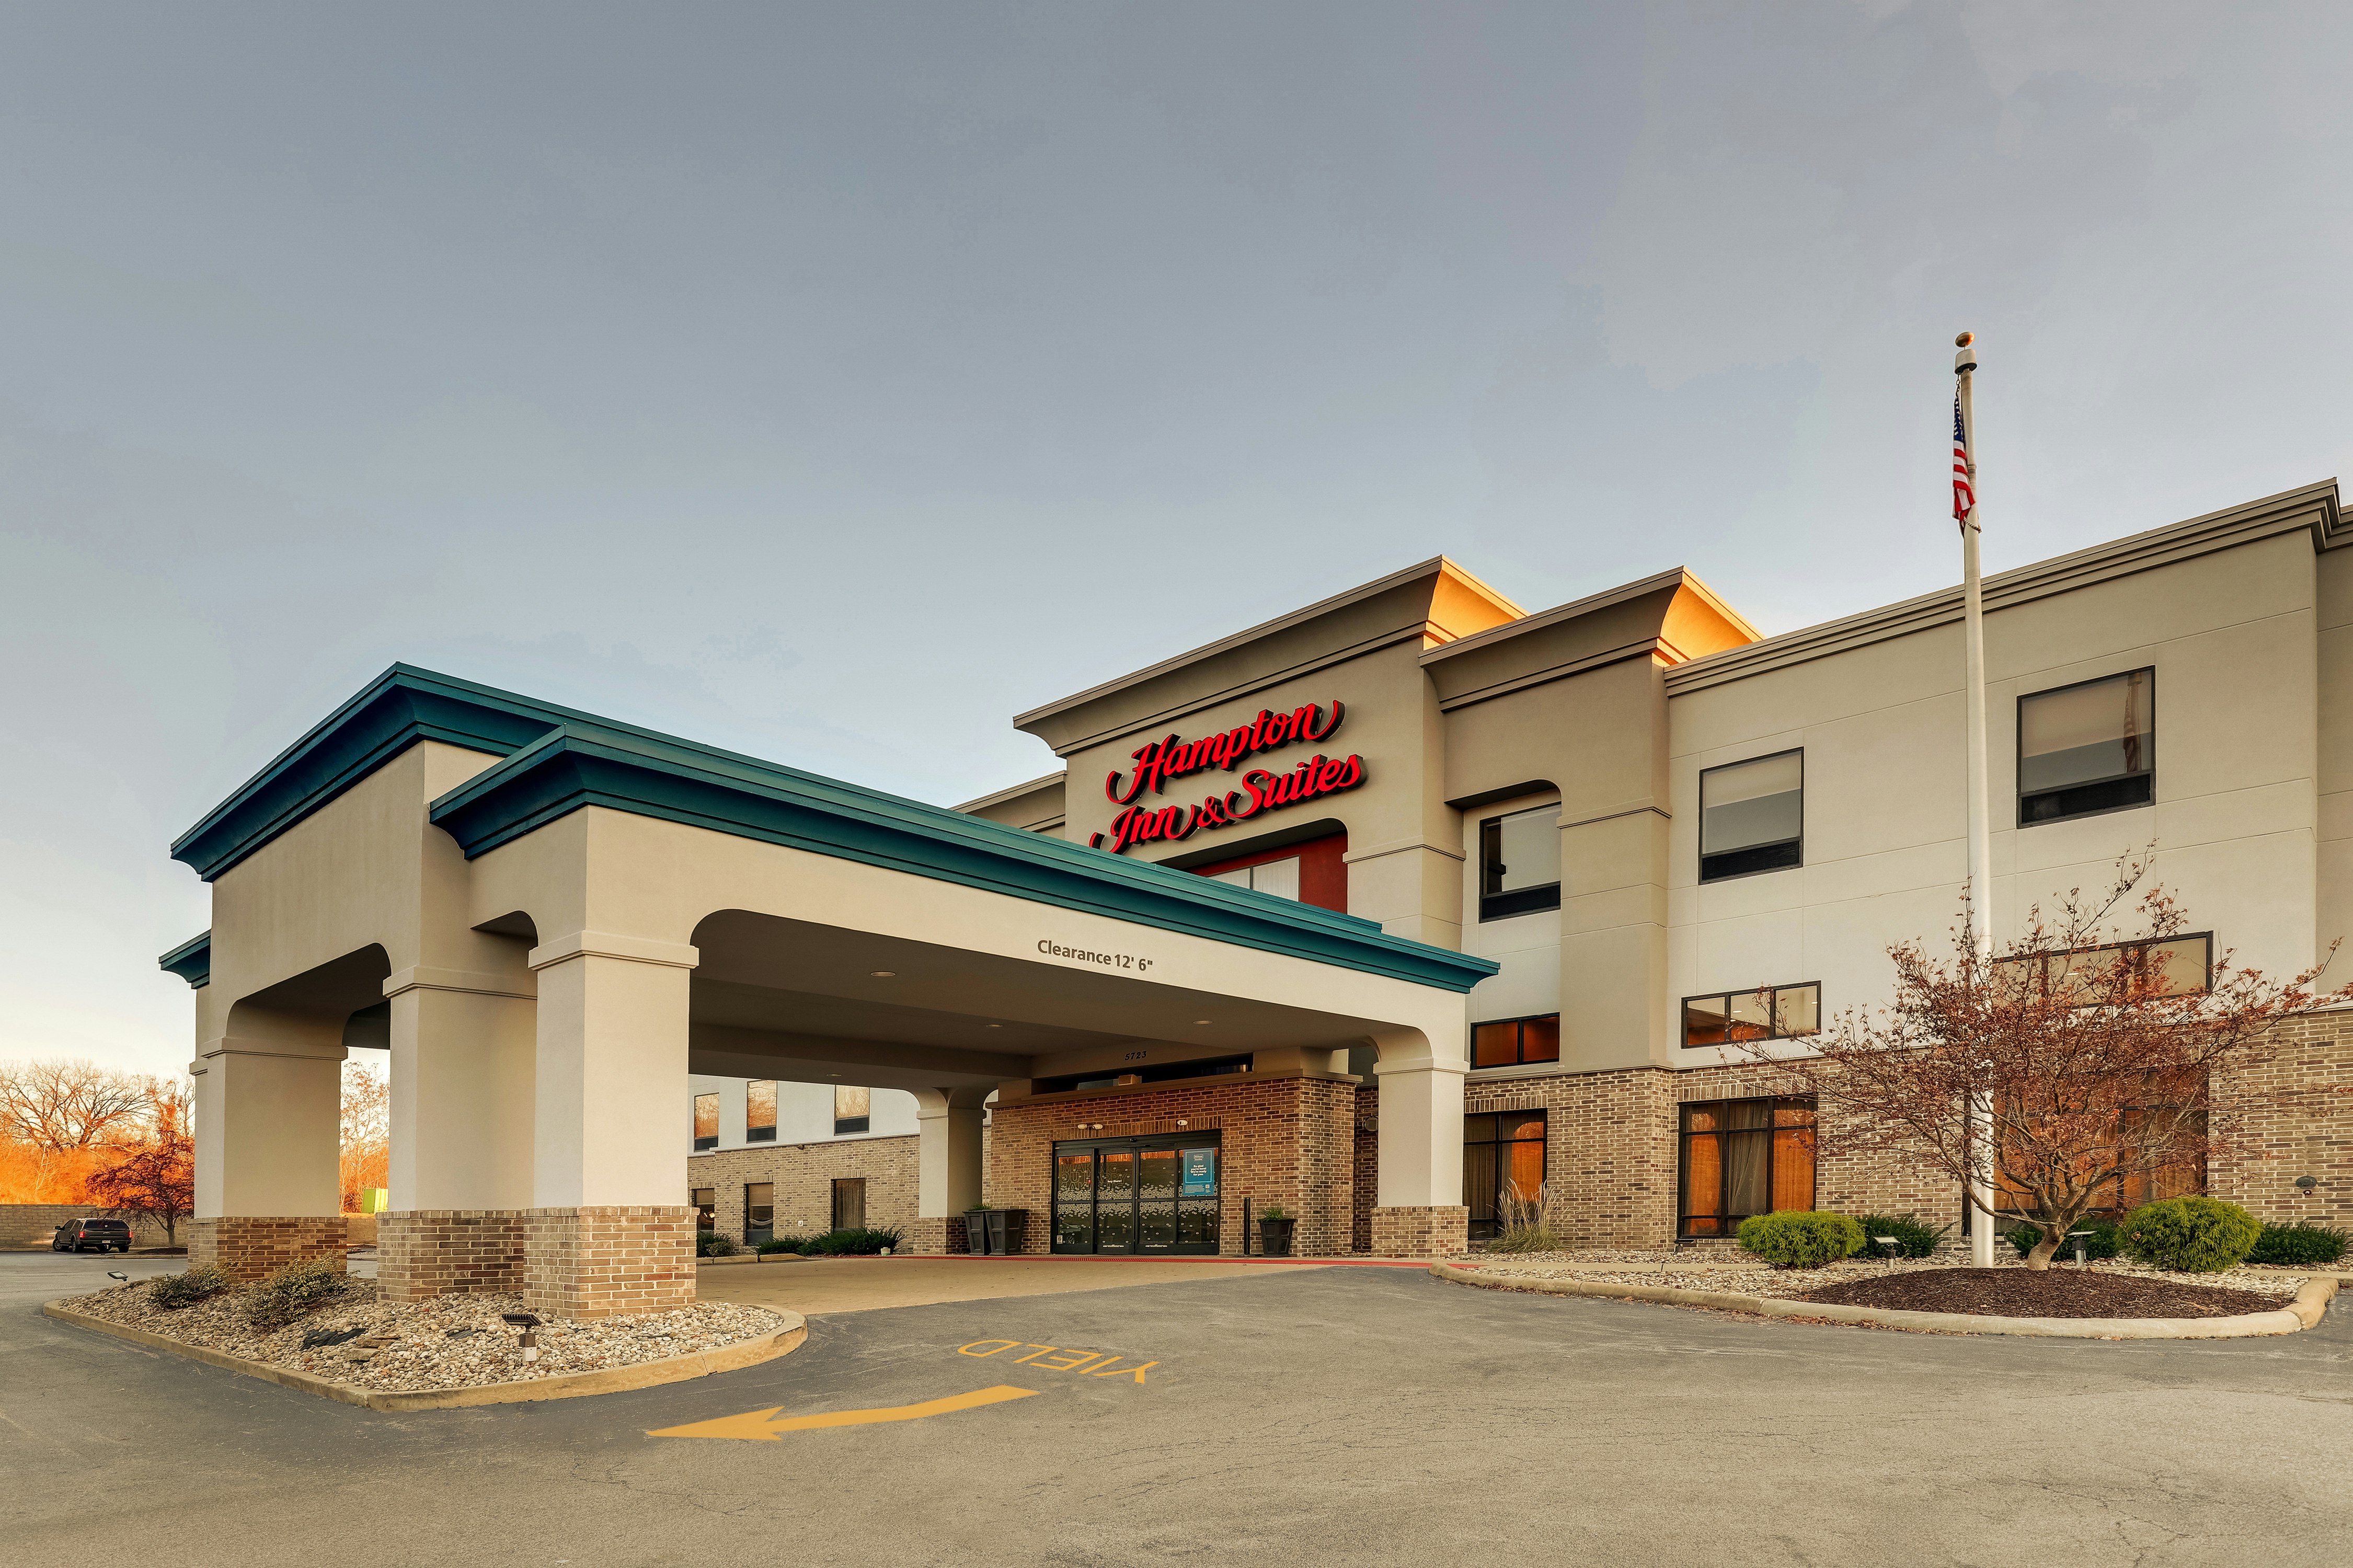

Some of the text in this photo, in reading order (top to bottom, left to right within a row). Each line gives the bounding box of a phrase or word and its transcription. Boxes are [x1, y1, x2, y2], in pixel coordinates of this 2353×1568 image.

[1106, 699, 1346, 805] Hampton
[1089, 753, 1369, 854] Inn & Suites
[1037, 939, 1153, 971] Clearance 12' 6"
[1124, 1050, 1147, 1061] 5723
[957, 1339, 1161, 1384] YIELD
